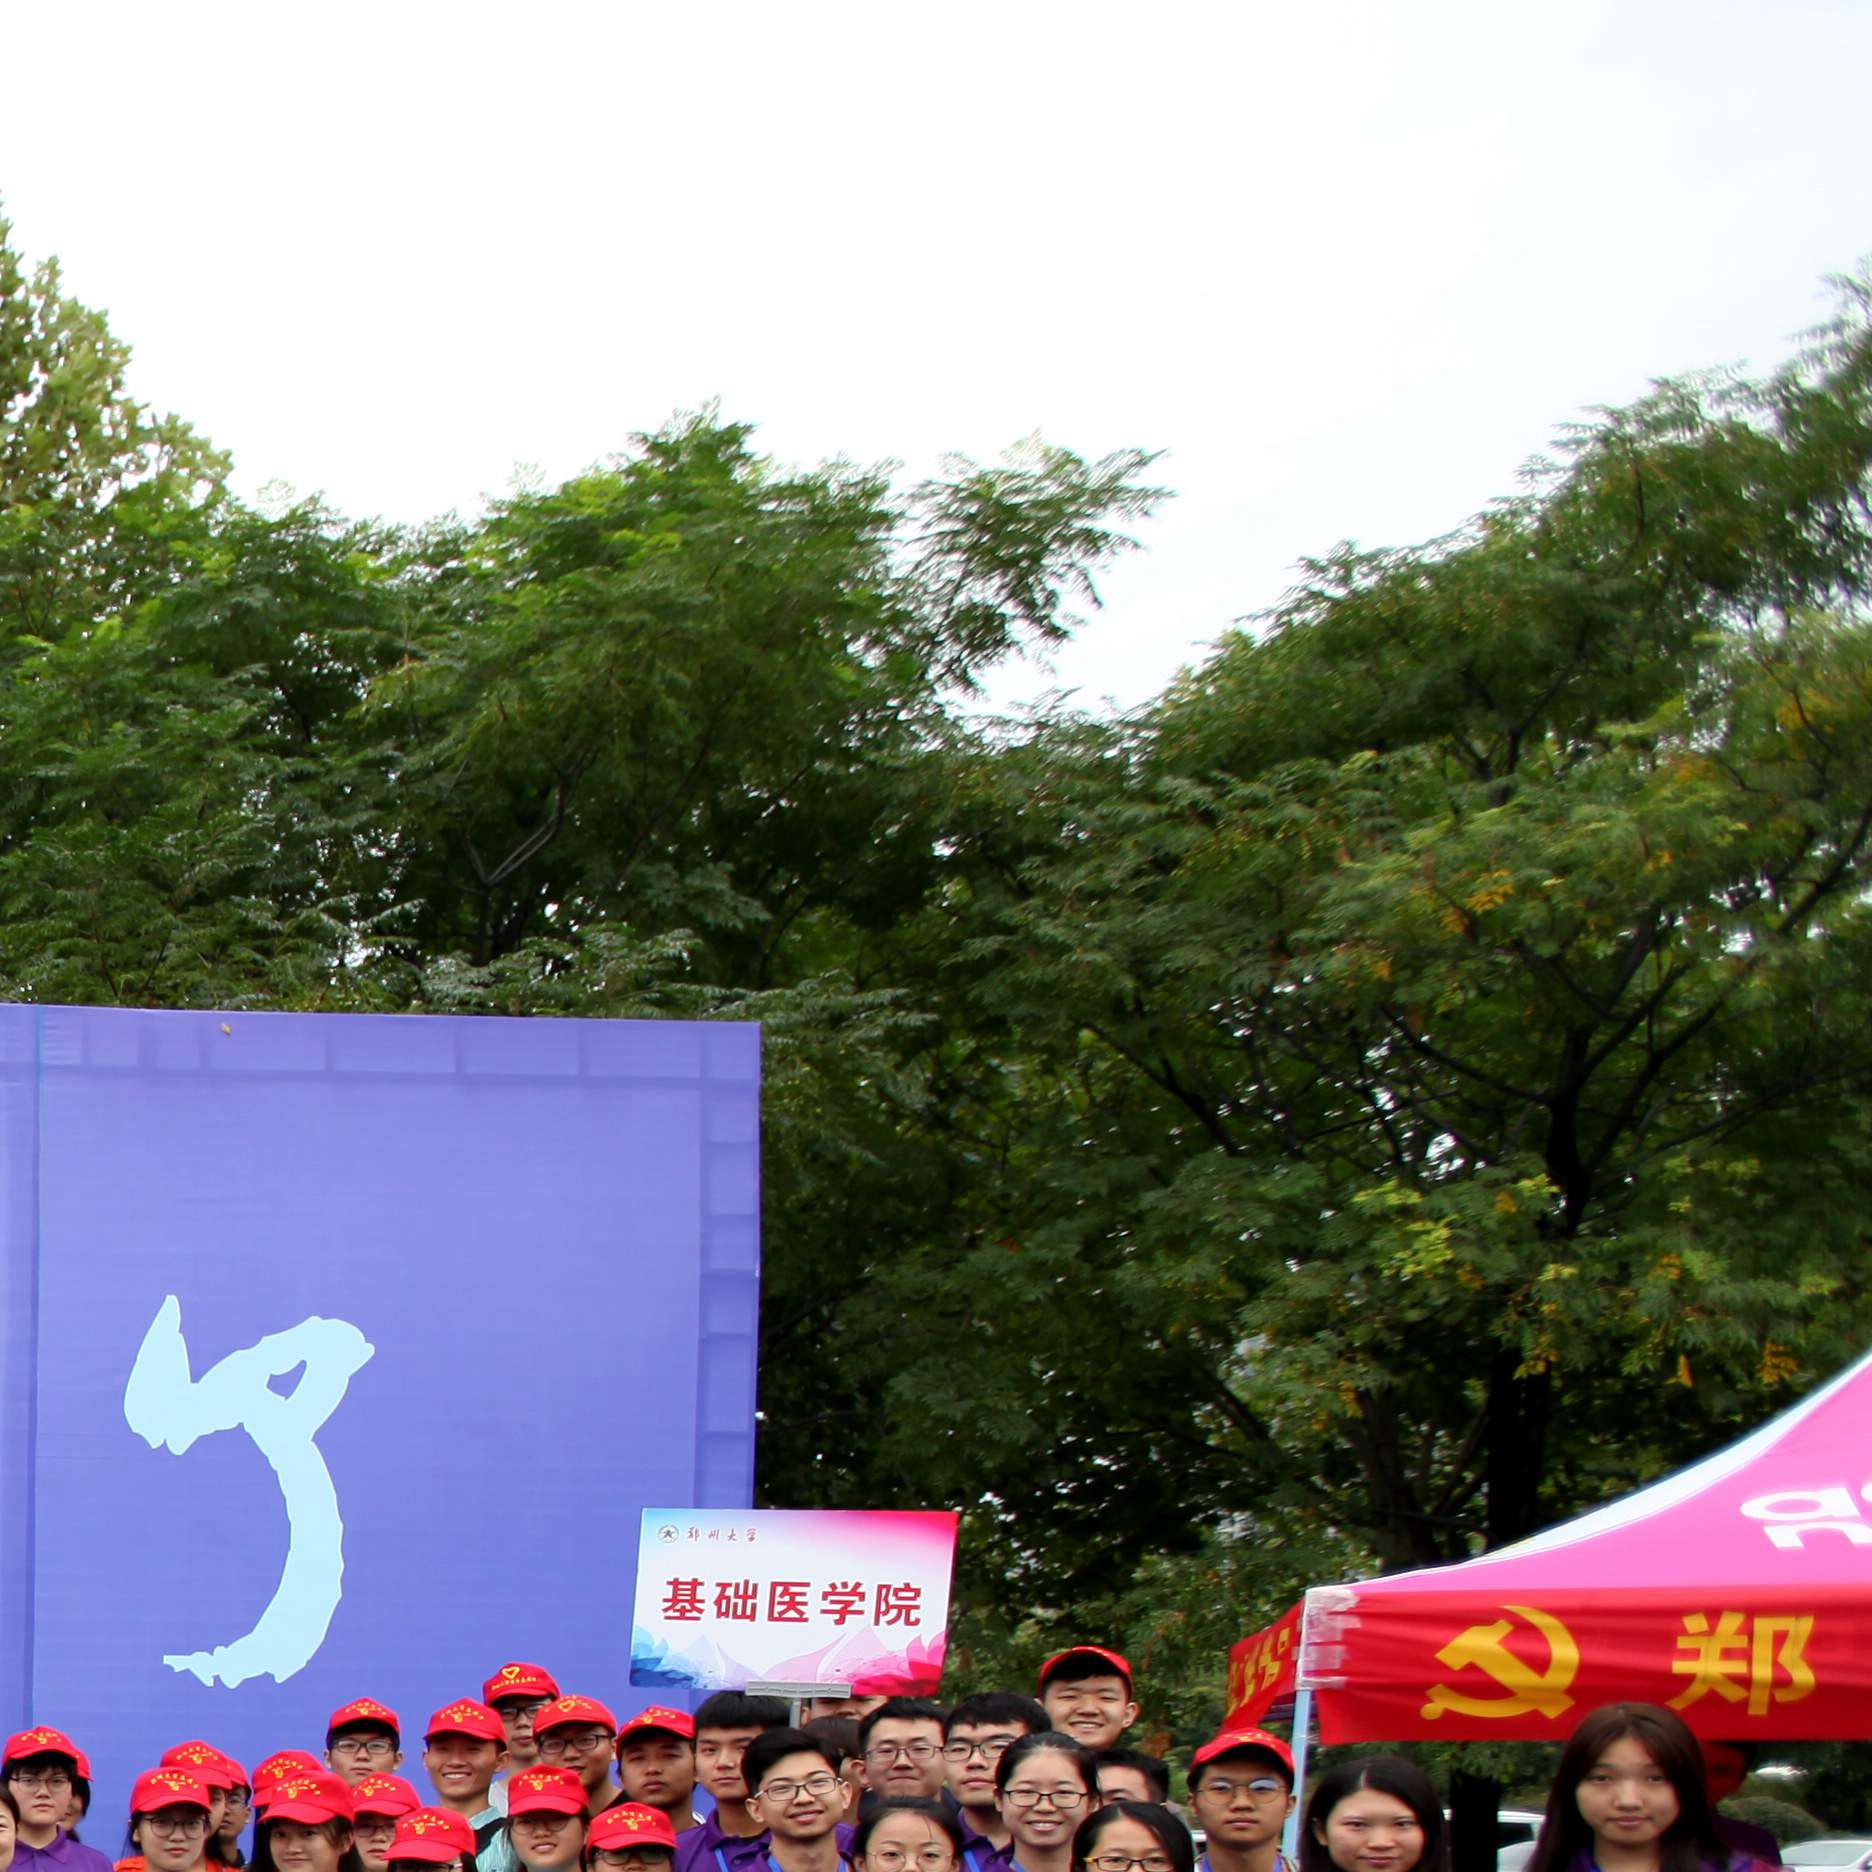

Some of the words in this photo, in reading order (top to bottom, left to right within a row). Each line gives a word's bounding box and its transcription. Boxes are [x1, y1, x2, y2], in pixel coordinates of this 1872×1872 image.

[661, 1577, 923, 1627] 基础医学院
[1667, 1611, 1816, 1716] 郑
